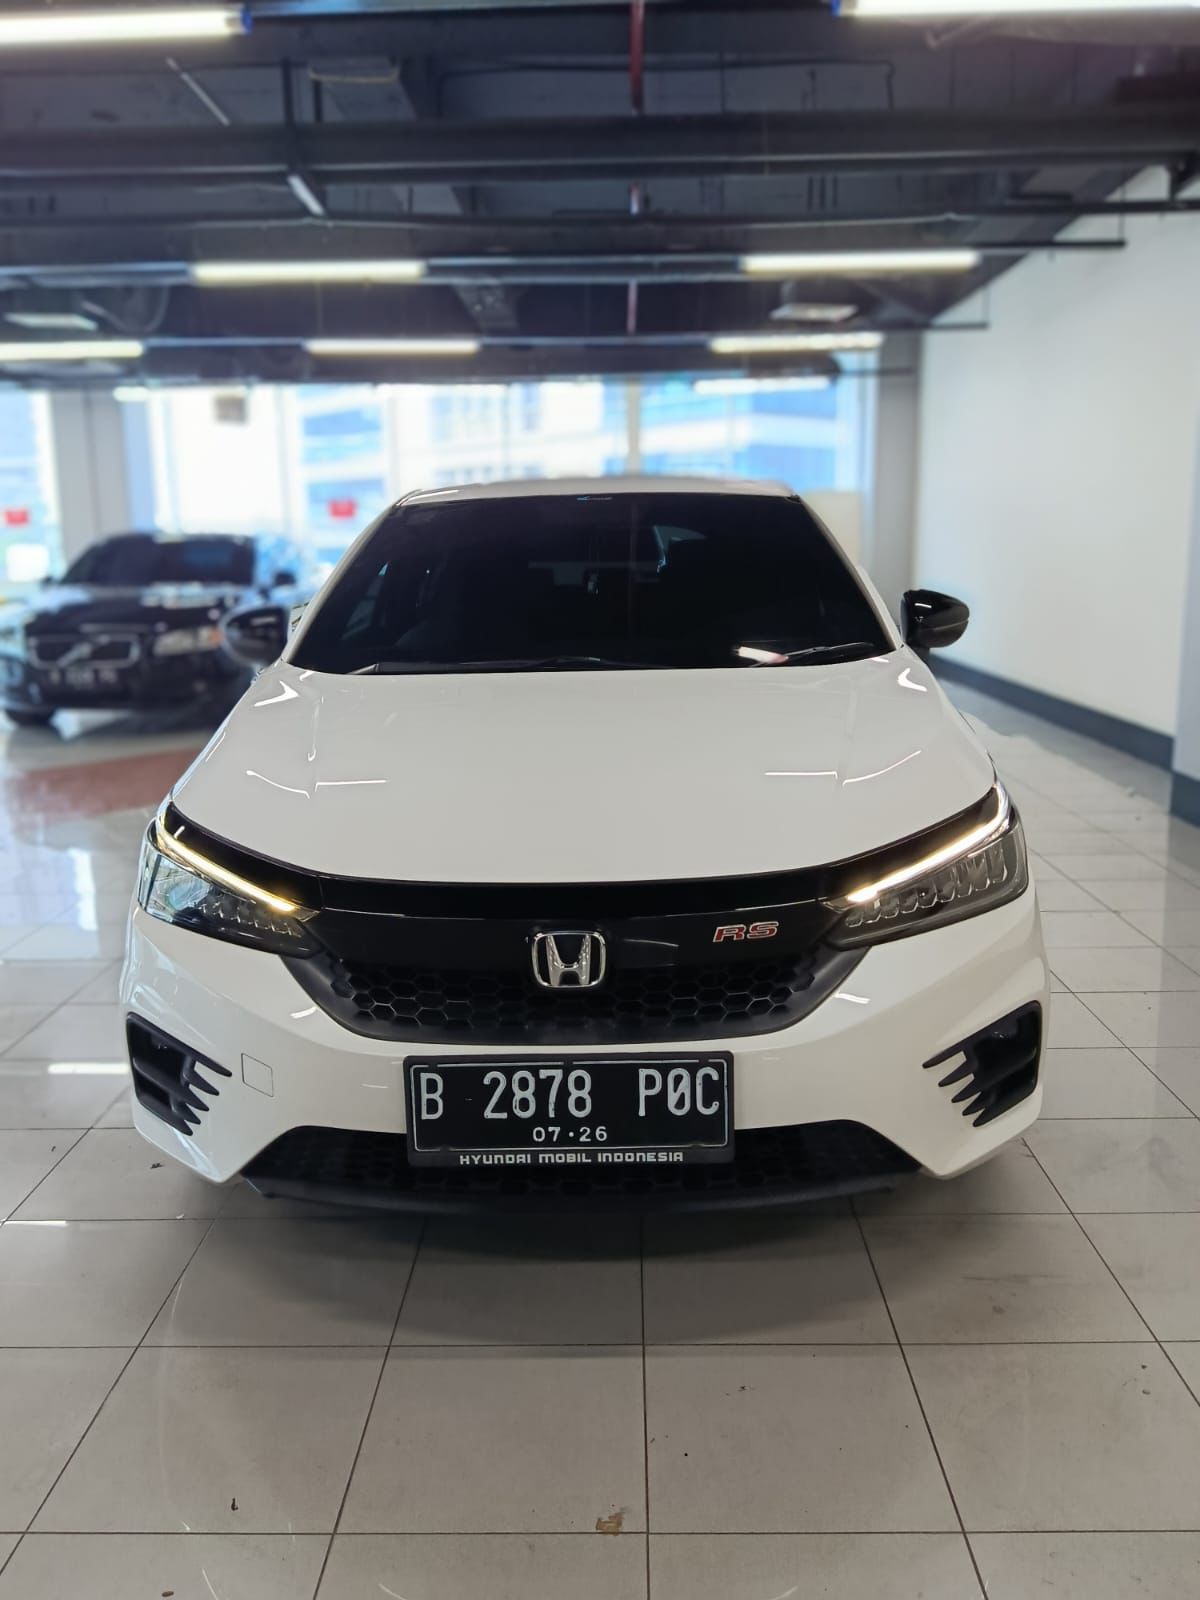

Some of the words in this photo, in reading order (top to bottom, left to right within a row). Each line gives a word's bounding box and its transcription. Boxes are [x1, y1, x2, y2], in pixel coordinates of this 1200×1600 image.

[712, 921, 779, 943] RS
[420, 1072, 444, 1120] B
[483, 1069, 592, 1119] 2878
[459, 1153, 532, 1165] HYUNDAI
[538, 1152, 592, 1164] MOBIL
[597, 1151, 684, 1163] INDONESIA
